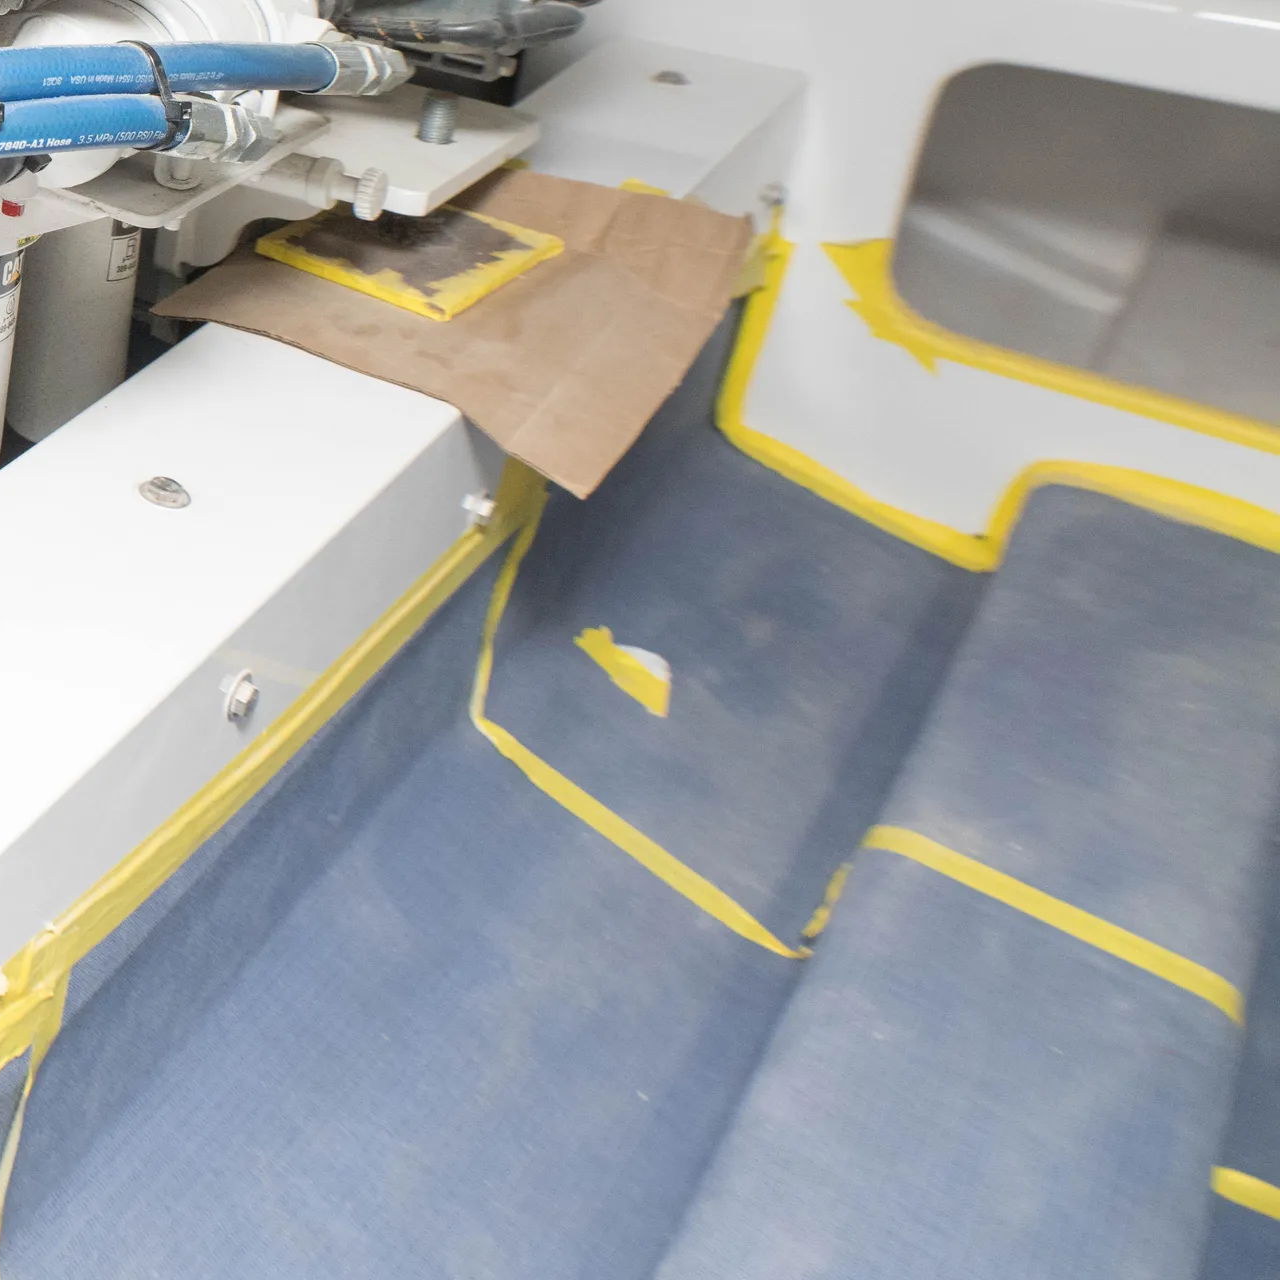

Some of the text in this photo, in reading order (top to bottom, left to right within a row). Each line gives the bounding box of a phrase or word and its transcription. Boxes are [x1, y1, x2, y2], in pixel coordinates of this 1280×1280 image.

[69, 74, 85, 84] USA
[94, 73, 114, 83] Made
[46, 136, 72, 149] Hose
[77, 133, 94, 145] 3.5
[94, 131, 114, 144] MPa
